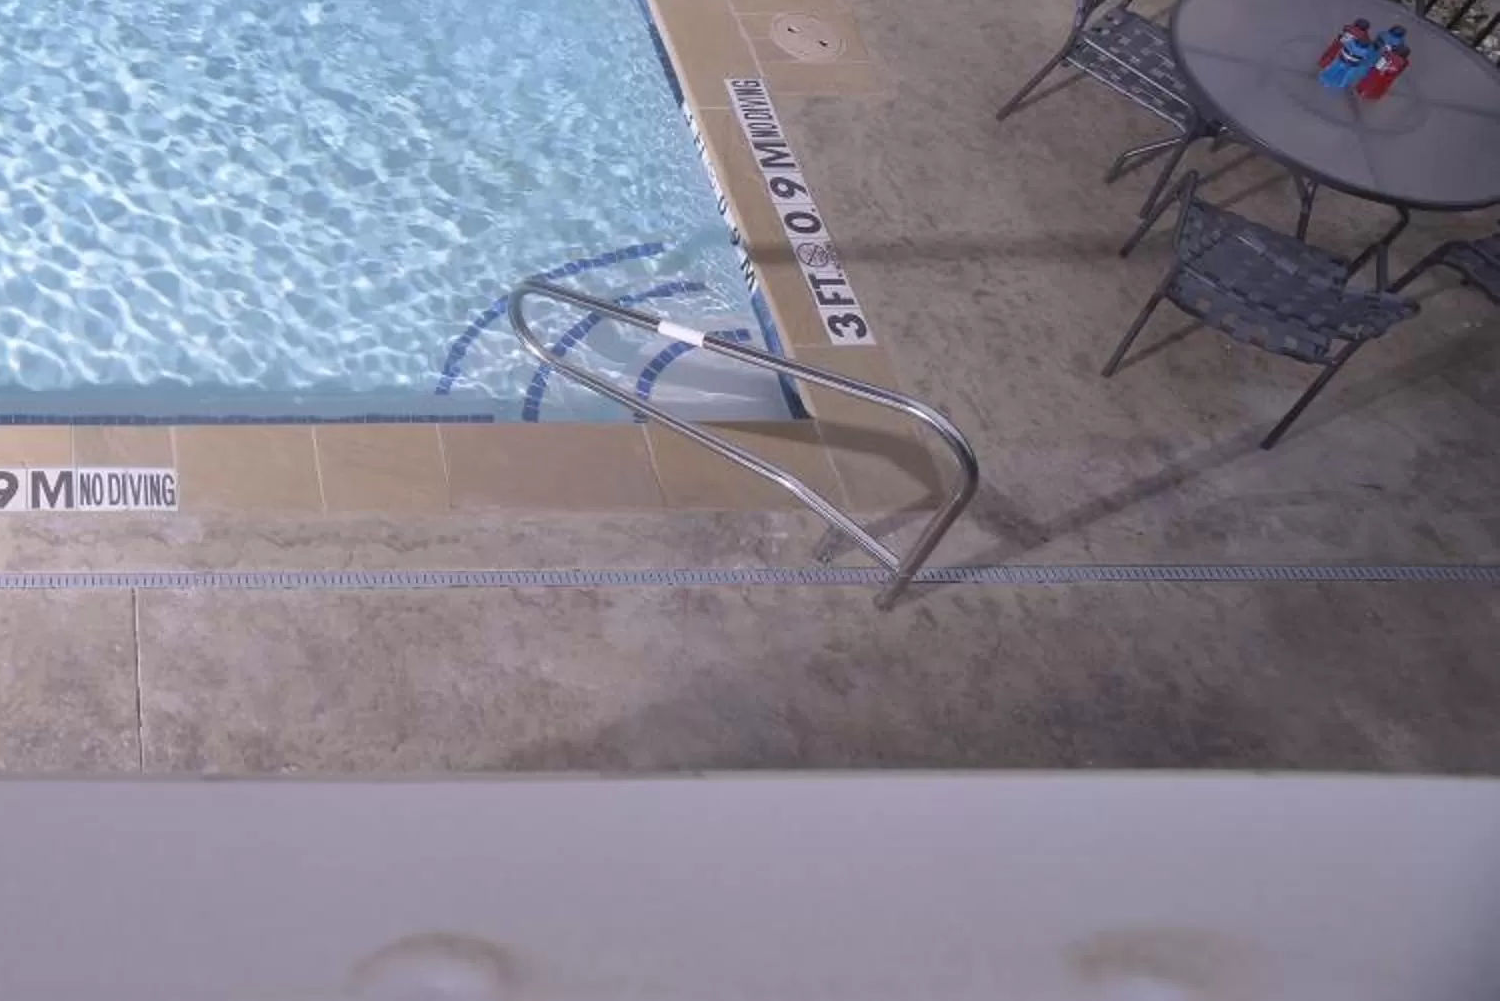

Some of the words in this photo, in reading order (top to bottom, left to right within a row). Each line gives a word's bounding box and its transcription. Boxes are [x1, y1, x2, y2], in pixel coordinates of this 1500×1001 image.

[731, 79, 774, 120] DIVING
[79, 473, 104, 508] NO
[107, 473, 177, 508] DIVING
